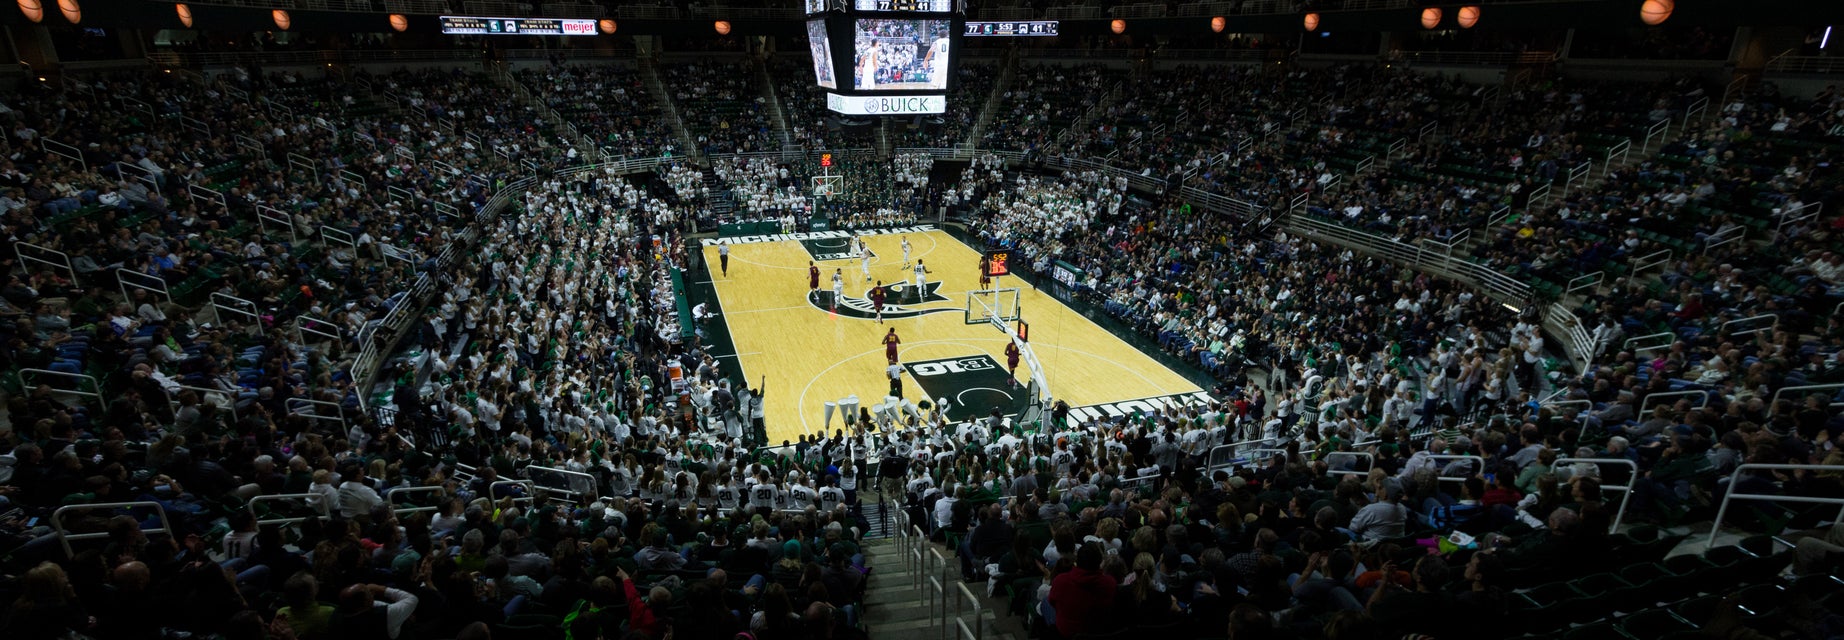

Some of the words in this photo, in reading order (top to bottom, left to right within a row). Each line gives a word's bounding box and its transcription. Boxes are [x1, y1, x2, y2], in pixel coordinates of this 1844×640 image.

[918, 2, 928, 10] 41
[564, 21, 594, 33] meijer
[1032, 24, 1042, 32] 41
[882, 98, 928, 112] BUICK
[703, 230, 852, 246] MICHIGAN
[1198, 432, 1206, 442] 20
[715, 444, 724, 454] 20
[992, 447, 1001, 456] 20
[1059, 454, 1070, 464] 20
[917, 482, 930, 492] 20
[718, 490, 732, 500] 20
[757, 489, 772, 500] 20
[794, 490, 806, 501] 20
[822, 492, 836, 502] 20
